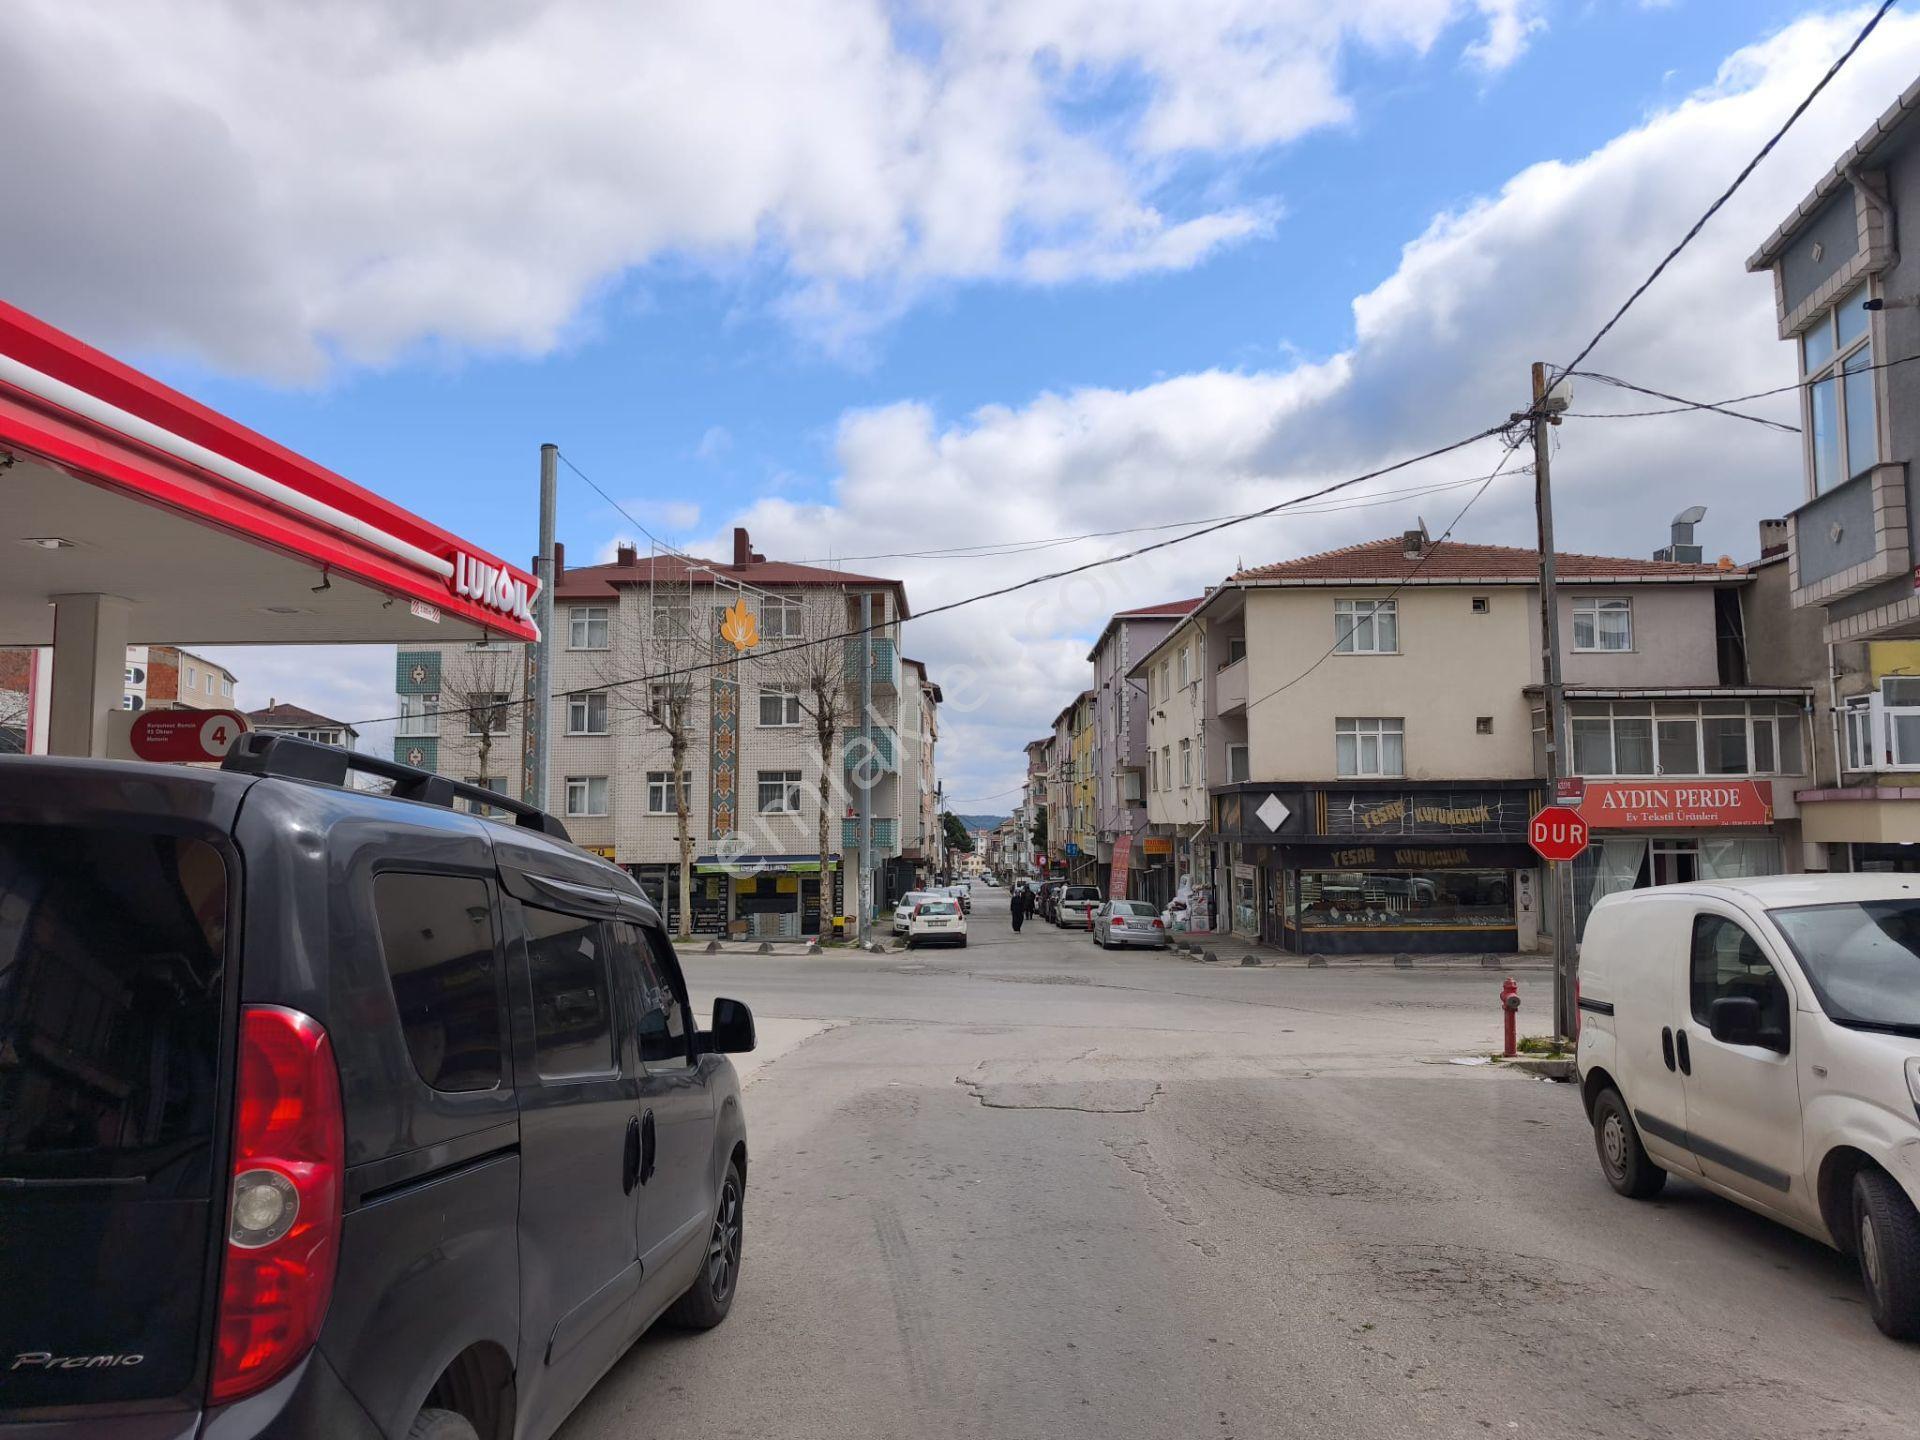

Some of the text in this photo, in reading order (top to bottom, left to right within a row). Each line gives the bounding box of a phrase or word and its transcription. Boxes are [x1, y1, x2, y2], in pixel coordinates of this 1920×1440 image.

[456, 551, 528, 620] LUKOIL
[211, 726, 227, 745] 4
[1601, 787, 1742, 809] AYDIN PERDE
[1414, 805, 1490, 825] KUYUMCULUK
[1626, 810, 1718, 821] Ev Tekstil Ürünleri
[1535, 822, 1583, 844] DUR
[11, 1352, 144, 1370] Premio
